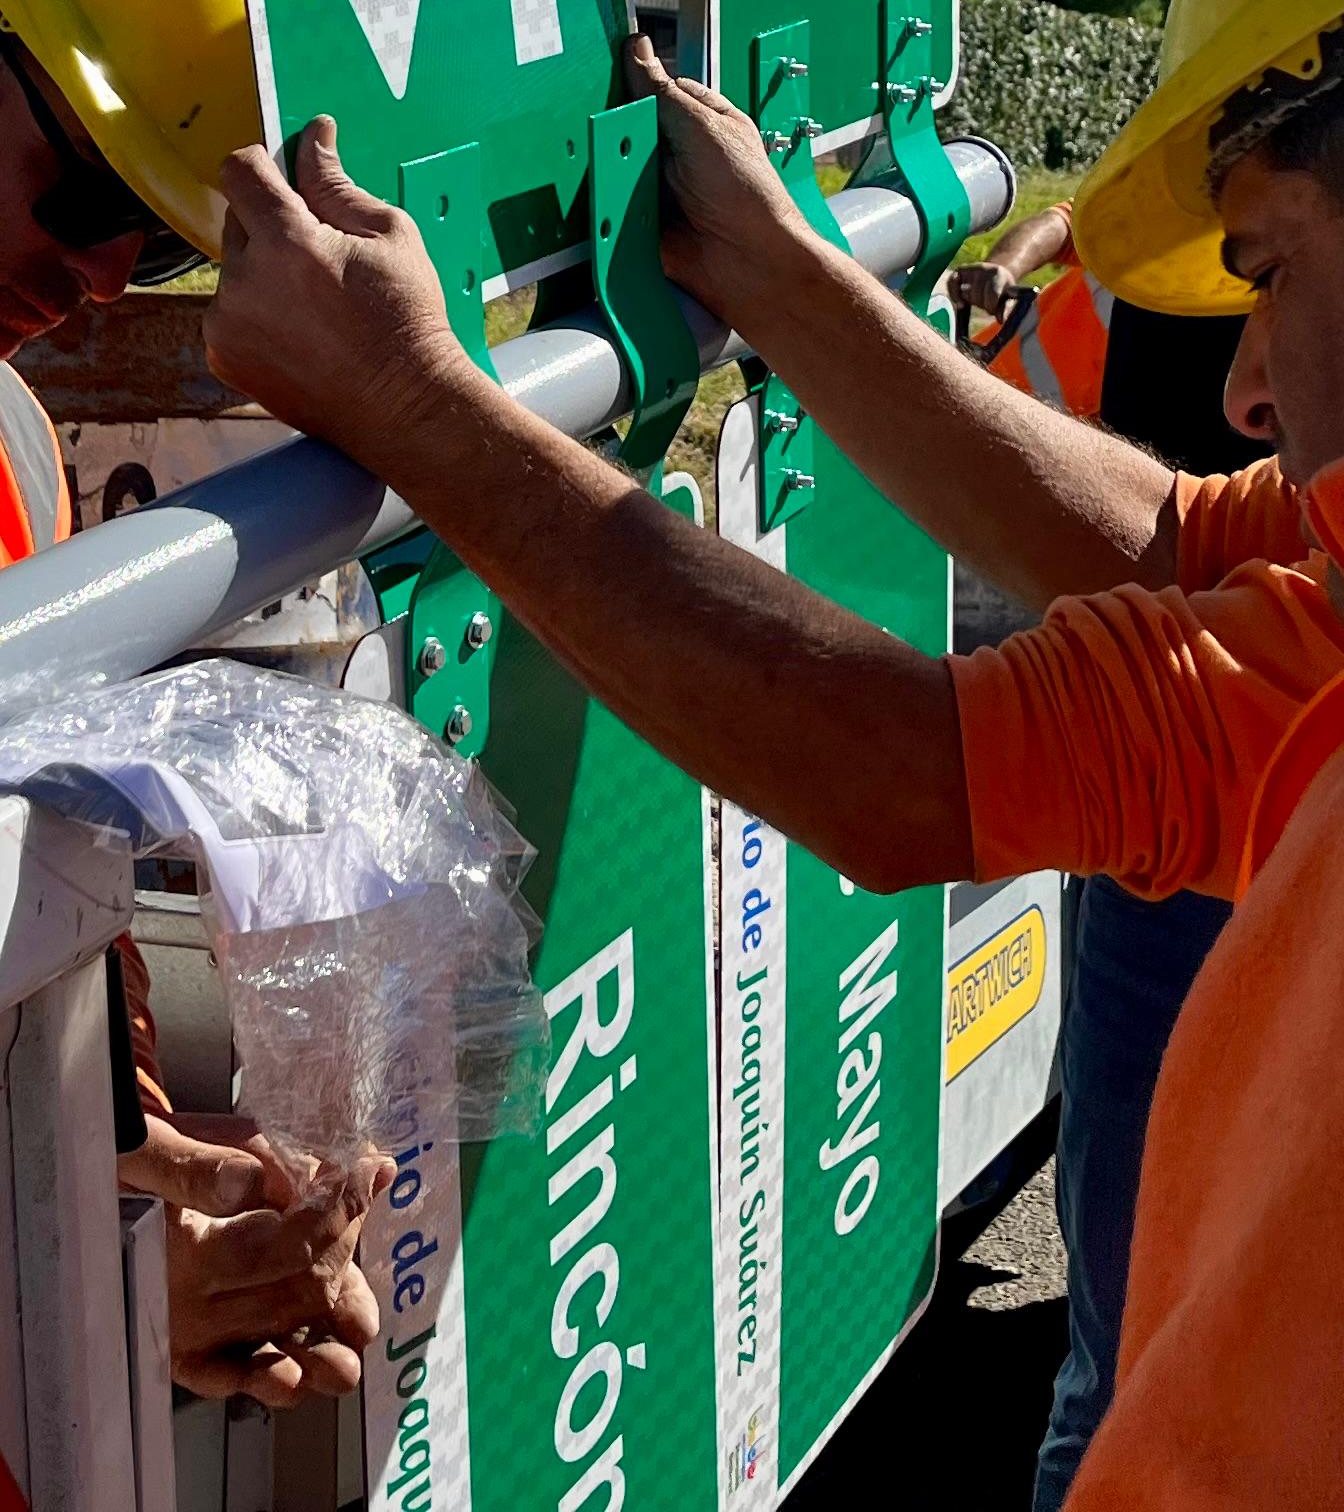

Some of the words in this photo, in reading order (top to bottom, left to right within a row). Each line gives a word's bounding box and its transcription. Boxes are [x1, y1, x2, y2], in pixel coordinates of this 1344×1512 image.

[741, 888, 771, 954] de
[946, 928, 1032, 1044] ARTWICH
[733, 965, 769, 1186] Joaquín
[819, 918, 898, 1235] Mayo
[391, 1230, 438, 1313] de
[737, 1190, 768, 1377] Suárez
